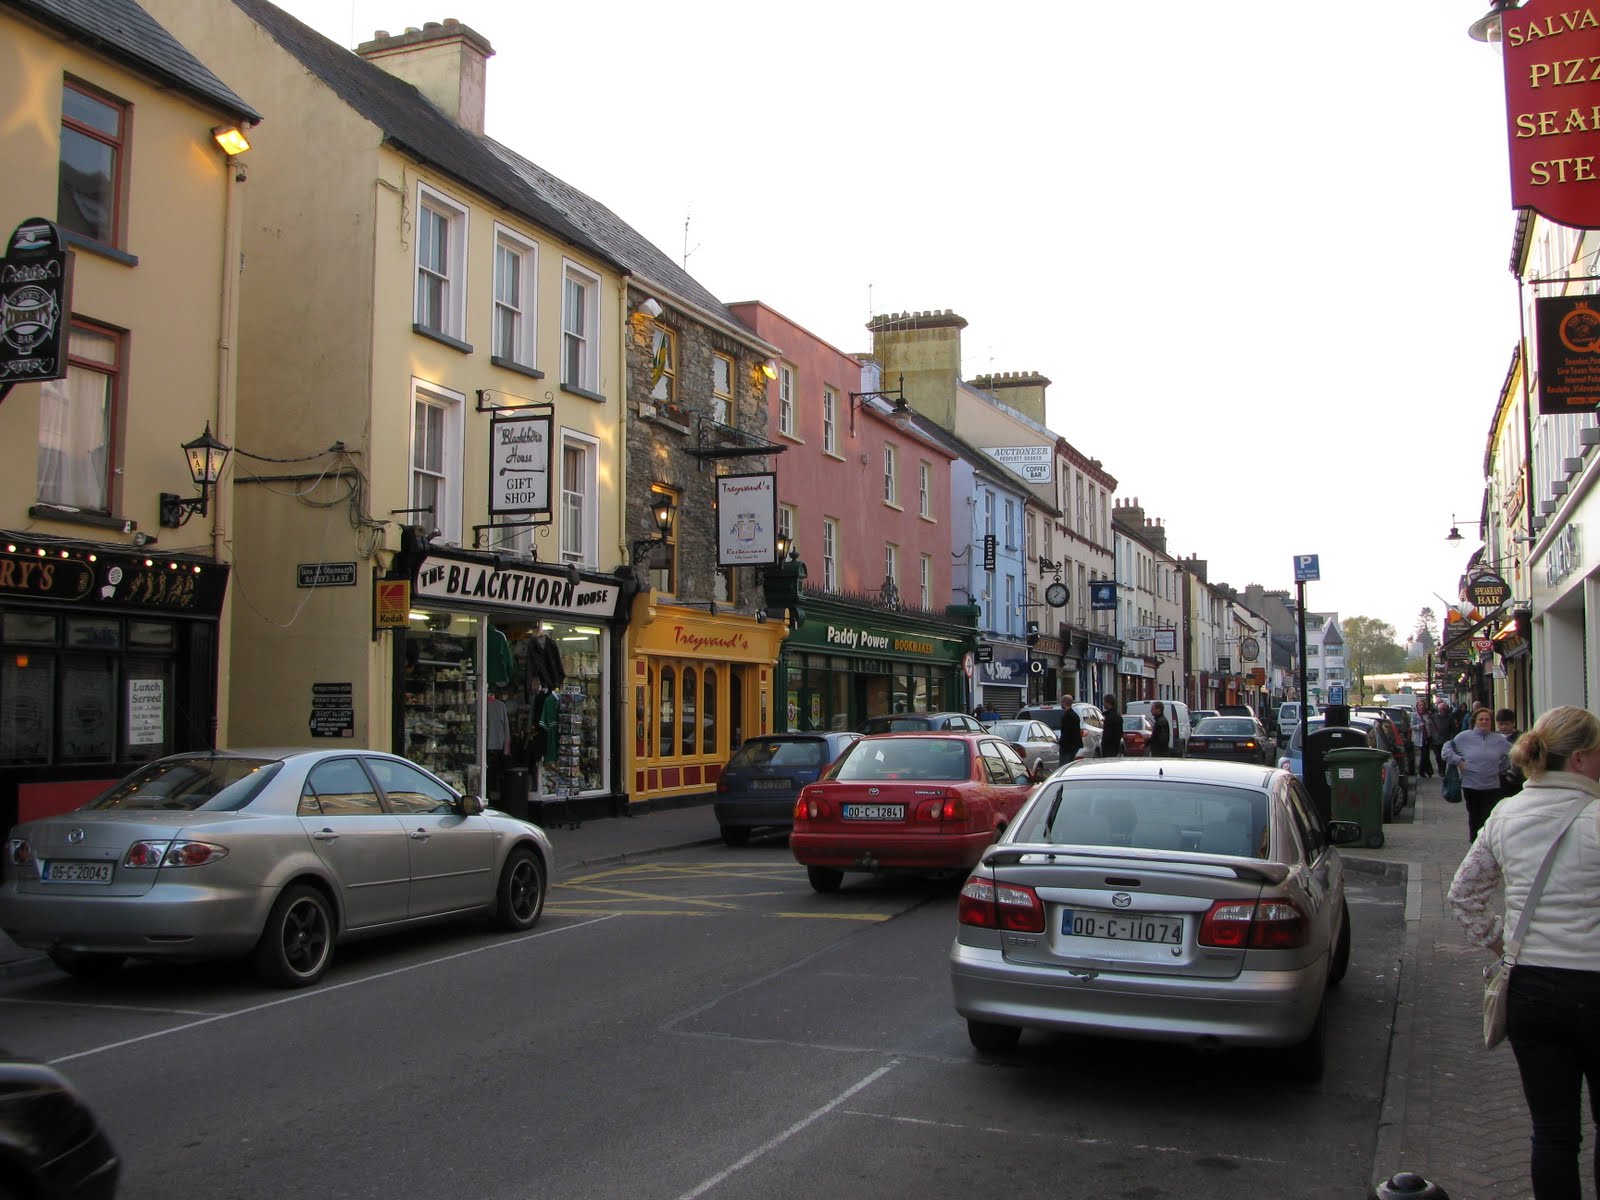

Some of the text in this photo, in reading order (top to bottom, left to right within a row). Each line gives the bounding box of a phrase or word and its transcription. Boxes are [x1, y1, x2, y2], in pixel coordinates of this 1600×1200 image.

[1529, 155, 1600, 186] STE
[17, 334, 34, 344] BAR
[501, 426, 543, 446] Blackthorn
[505, 444, 533, 464] House
[994, 447, 1048, 456] AUCTIONEER
[192, 451, 204, 476] BAR
[506, 477, 533, 490] GIFT
[722, 480, 770, 496] Treyvaud's
[504, 491, 536, 504] SHOP
[726, 547, 768, 555] Restaurant
[1300, 556, 1312, 569] P
[332, 574, 350, 582] LANE
[420, 564, 609, 608] THE BLACKTHORN HOUSE
[1474, 586, 1504, 596] SPEAKEASY
[1477, 595, 1500, 605] BAR
[380, 613, 405, 623] Kodak
[673, 625, 749, 653] Treyvaud's
[827, 625, 889, 649] Paddy Power
[133, 682, 161, 692] Lunch
[131, 693, 162, 703] Served
[848, 807, 903, 818] 00-C-12841
[51, 865, 109, 880] 05-C-20043
[1073, 916, 1181, 943] 00-C-11074
